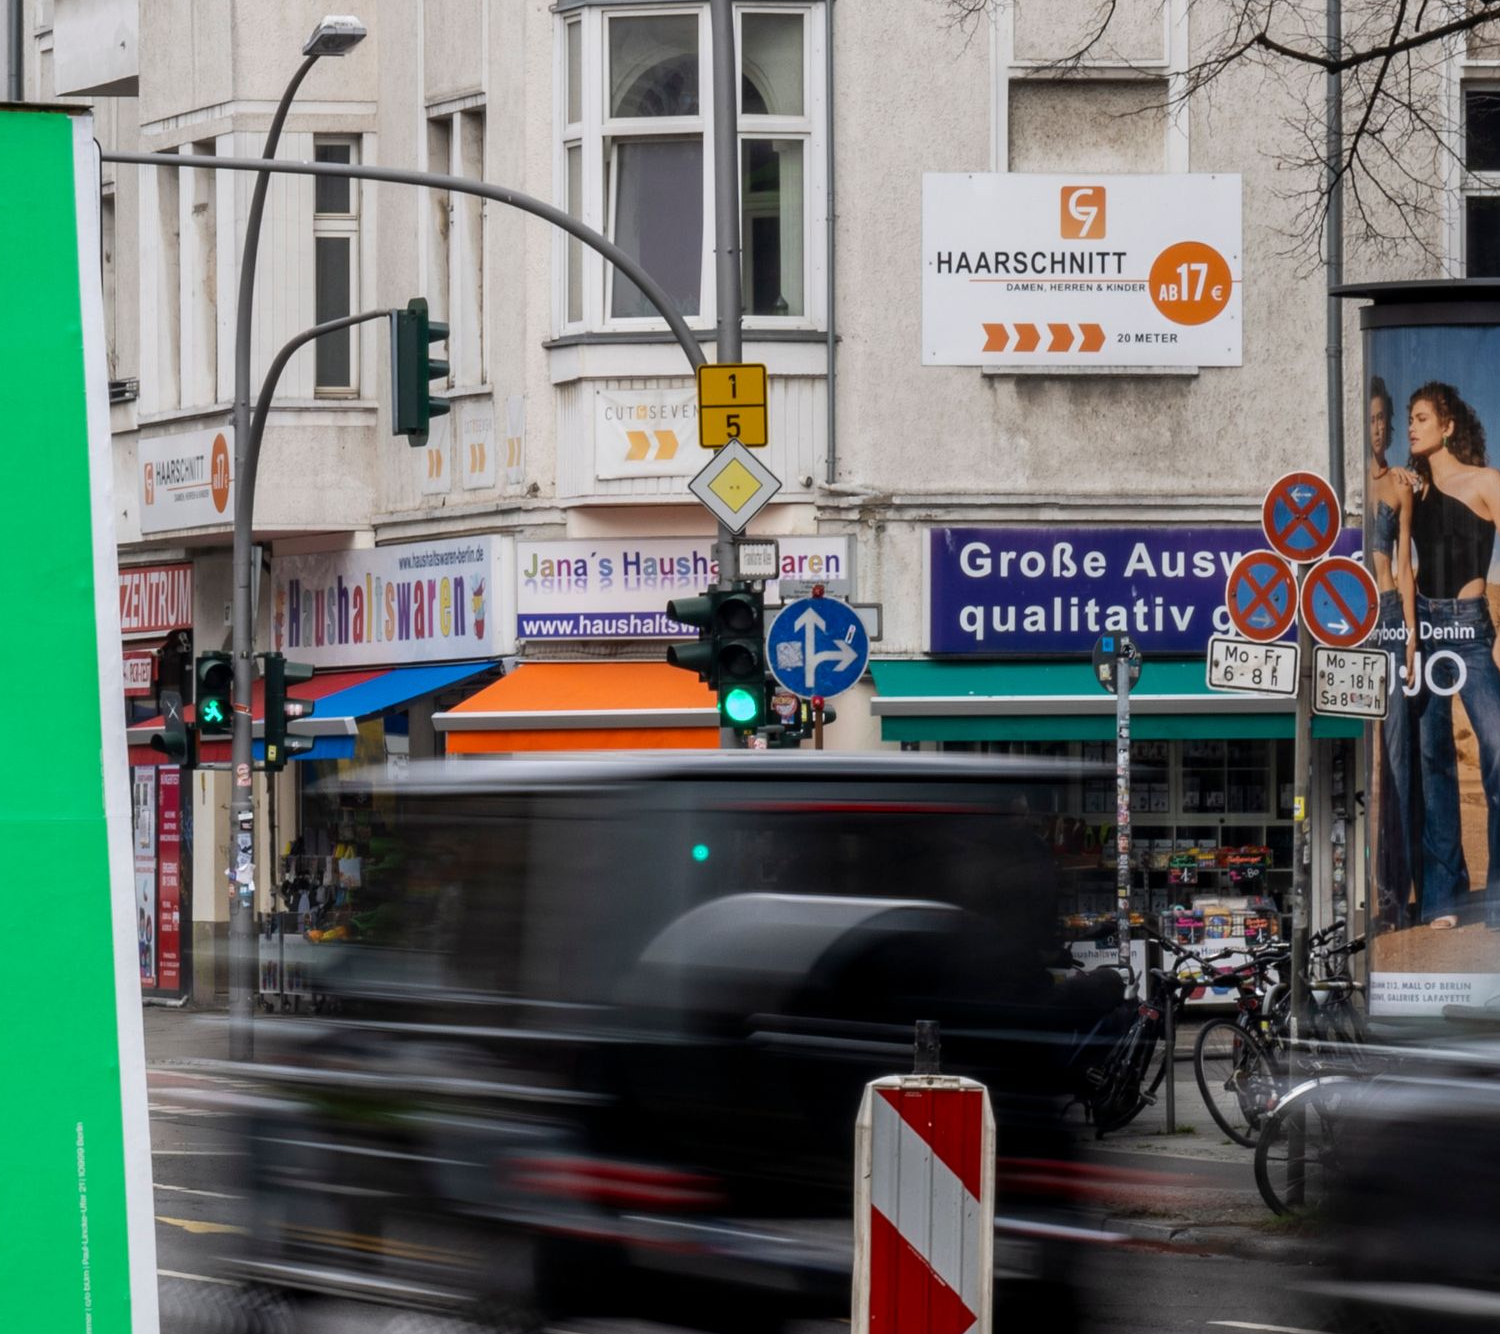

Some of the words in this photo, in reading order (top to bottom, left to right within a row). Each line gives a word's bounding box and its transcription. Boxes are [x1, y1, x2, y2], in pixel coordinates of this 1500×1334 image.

[936, 251, 1127, 275] HAARSCHNITT
[1006, 283, 1047, 293] DAMEN,
[1050, 283, 1093, 292] HERREN
[1096, 283, 1104, 292] &
[1106, 283, 1146, 292] KINDER
[1159, 283, 1178, 302] AB
[1176, 263, 1208, 302] 17
[1211, 286, 1223, 302] €
[1117, 333, 1131, 344] 20
[1135, 333, 1178, 344] METER
[728, 373, 738, 399] 1
[605, 406, 634, 420] CUT
[726, 414, 741, 440] 5
[155, 455, 205, 487] HAARSCHNITT
[398, 544, 484, 571] www.haushaltswaren-berlin.de
[959, 541, 1107, 579] Große
[288, 572, 466, 648] Haushaltswaren
[959, 597, 1195, 637] qualitativ
[1420, 621, 1475, 640] Denim
[1225, 646, 1249, 663] Mo
[1264, 650, 1281, 667] Fr
[1326, 654, 1346, 670] Mo
[1363, 657, 1377, 672] Fr
[1223, 665, 1234, 682] 6
[1252, 668, 1263, 685] 8
[1270, 669, 1278, 687] h
[1326, 674, 1335, 687] 8
[1351, 674, 1364, 689] 18
[1368, 675, 1374, 690] h
[1321, 690, 1337, 707] Sa
[1341, 693, 1348, 707] 8
[1374, 695, 1380, 710] h
[1402, 982, 1422, 990] MALL
[1424, 982, 1436, 990] OF
[1440, 982, 1472, 990] BERLIN
[1422, 994, 1471, 1002] LAFAYETTE
